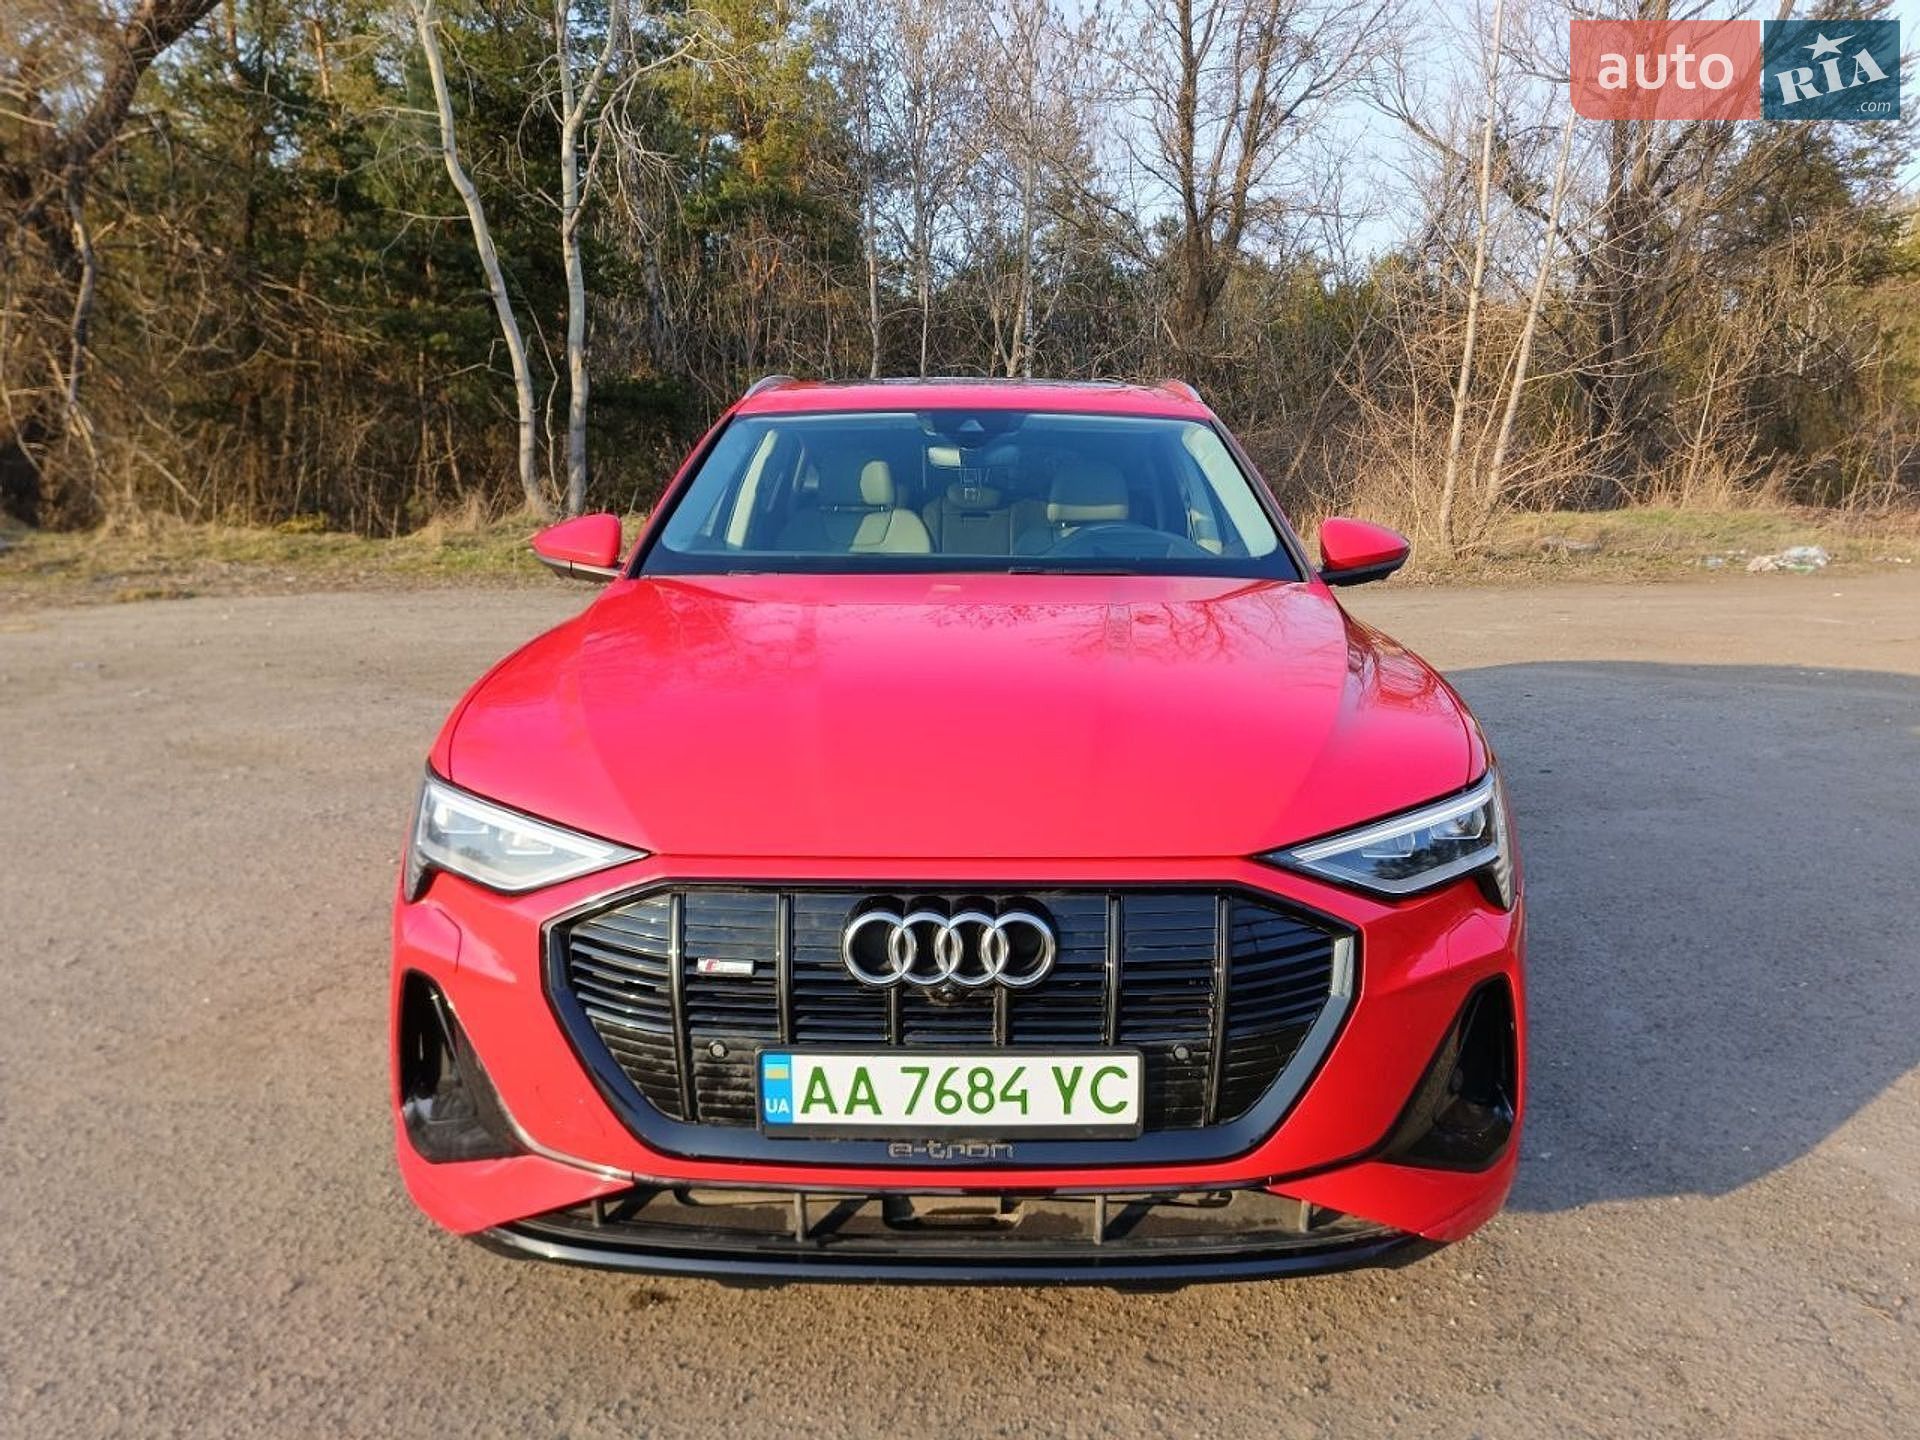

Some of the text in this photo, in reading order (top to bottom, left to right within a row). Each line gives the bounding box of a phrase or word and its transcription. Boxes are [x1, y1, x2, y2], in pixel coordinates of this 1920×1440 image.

[800, 1066, 1129, 1116] AA 7684 YC
[765, 1098, 790, 1114] UA
[887, 1141, 1014, 1158] e-tron
